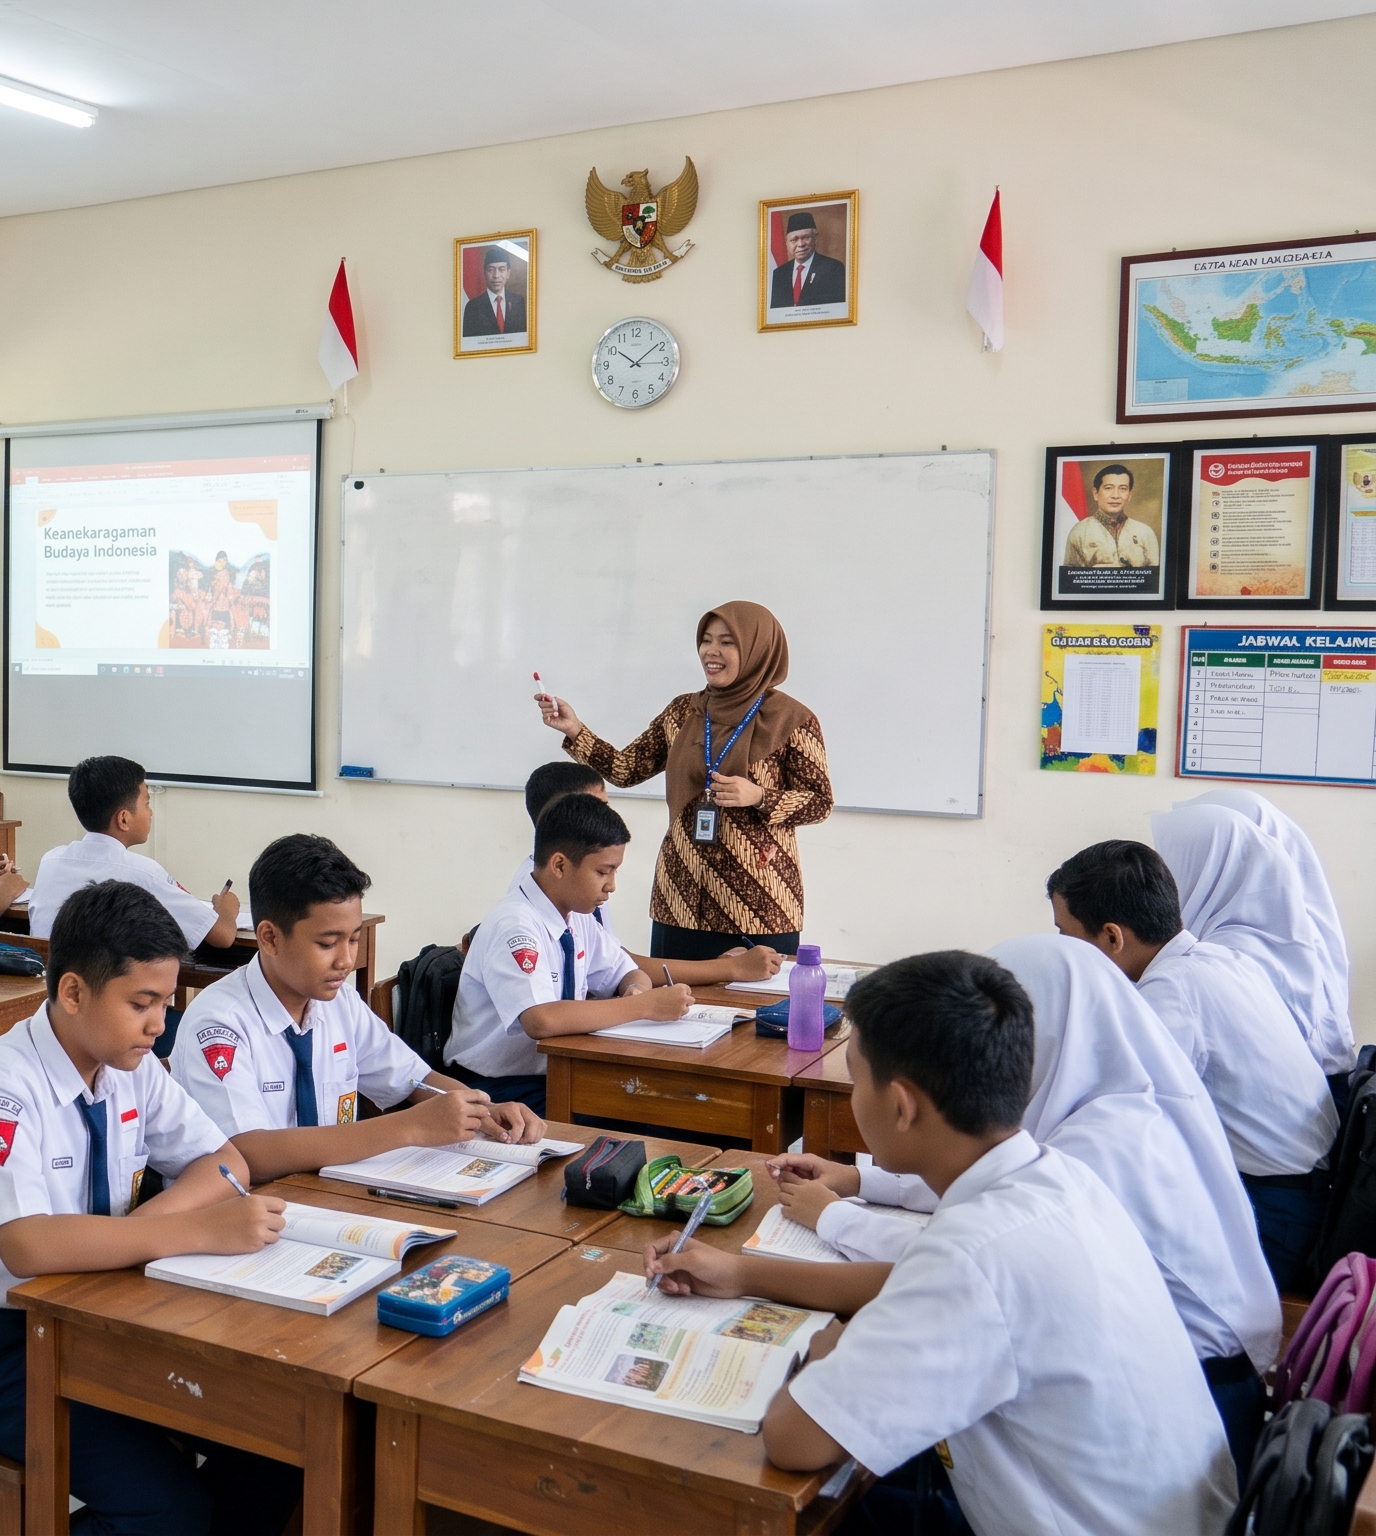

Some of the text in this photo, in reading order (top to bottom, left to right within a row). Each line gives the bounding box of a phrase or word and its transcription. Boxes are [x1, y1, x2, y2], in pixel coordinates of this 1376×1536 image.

[631, 328, 641, 337] 12
[618, 333, 626, 343] 11
[659, 341, 666, 351] 2
[603, 360, 610, 370] 9
[663, 357, 669, 366] 3
[607, 375, 614, 385] 8
[658, 372, 664, 382] 4
[618, 386, 624, 396] 7
[632, 389, 639, 399] 6
[648, 384, 654, 394] 5
[44, 526, 156, 542] Keanekaragaman
[44, 543, 157, 561] Budaya Indonesia
